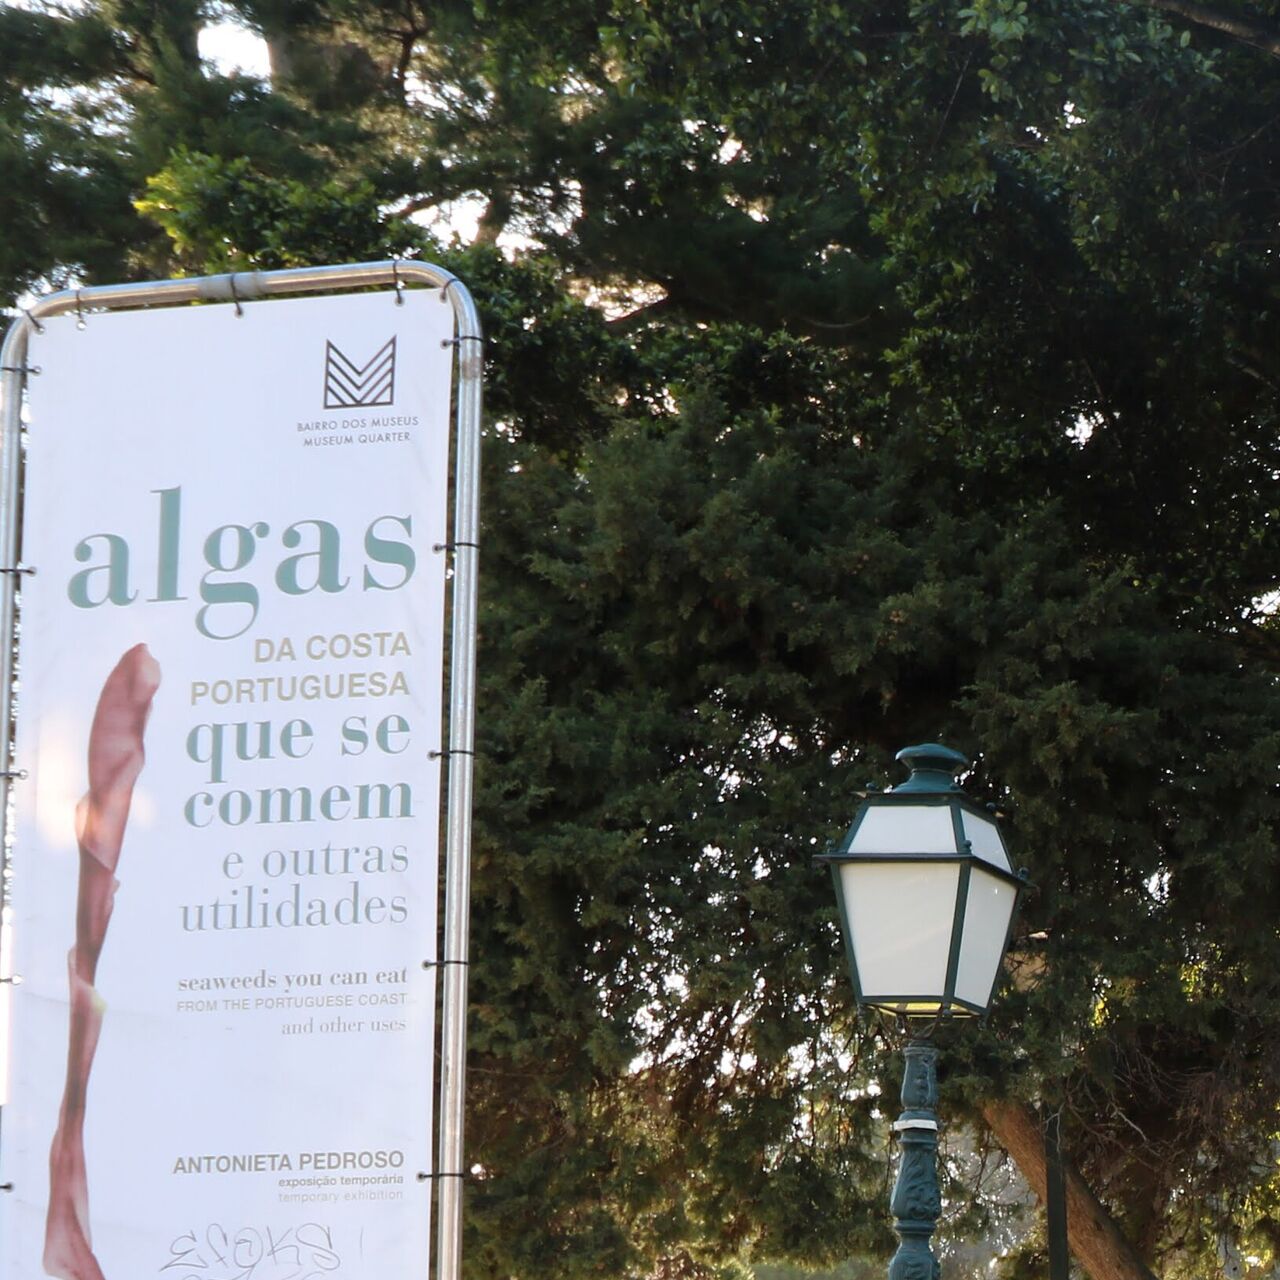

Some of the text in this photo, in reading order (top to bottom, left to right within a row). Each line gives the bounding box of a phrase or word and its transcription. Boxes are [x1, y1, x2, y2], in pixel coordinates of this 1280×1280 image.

[297, 416, 419, 432] BAIRRO DOS MUSEUS
[303, 432, 410, 446] MUSEUM QUARTER
[67, 485, 417, 640] algas
[255, 632, 411, 663] DA COSTA
[190, 671, 410, 705] PORTUGUESA
[185, 713, 411, 784] que se
[183, 781, 413, 827] comem
[222, 842, 409, 880] e outras
[180, 881, 409, 933] utilidades
[178, 968, 408, 994] seaweeds you can eat
[177, 993, 407, 1012] FROM THE PORTUGUESE COAST
[281, 1017, 406, 1035] and other uses
[173, 1150, 404, 1175] ANTONIETA PEDROSO
[278, 1173, 404, 1188] exposição temporária
